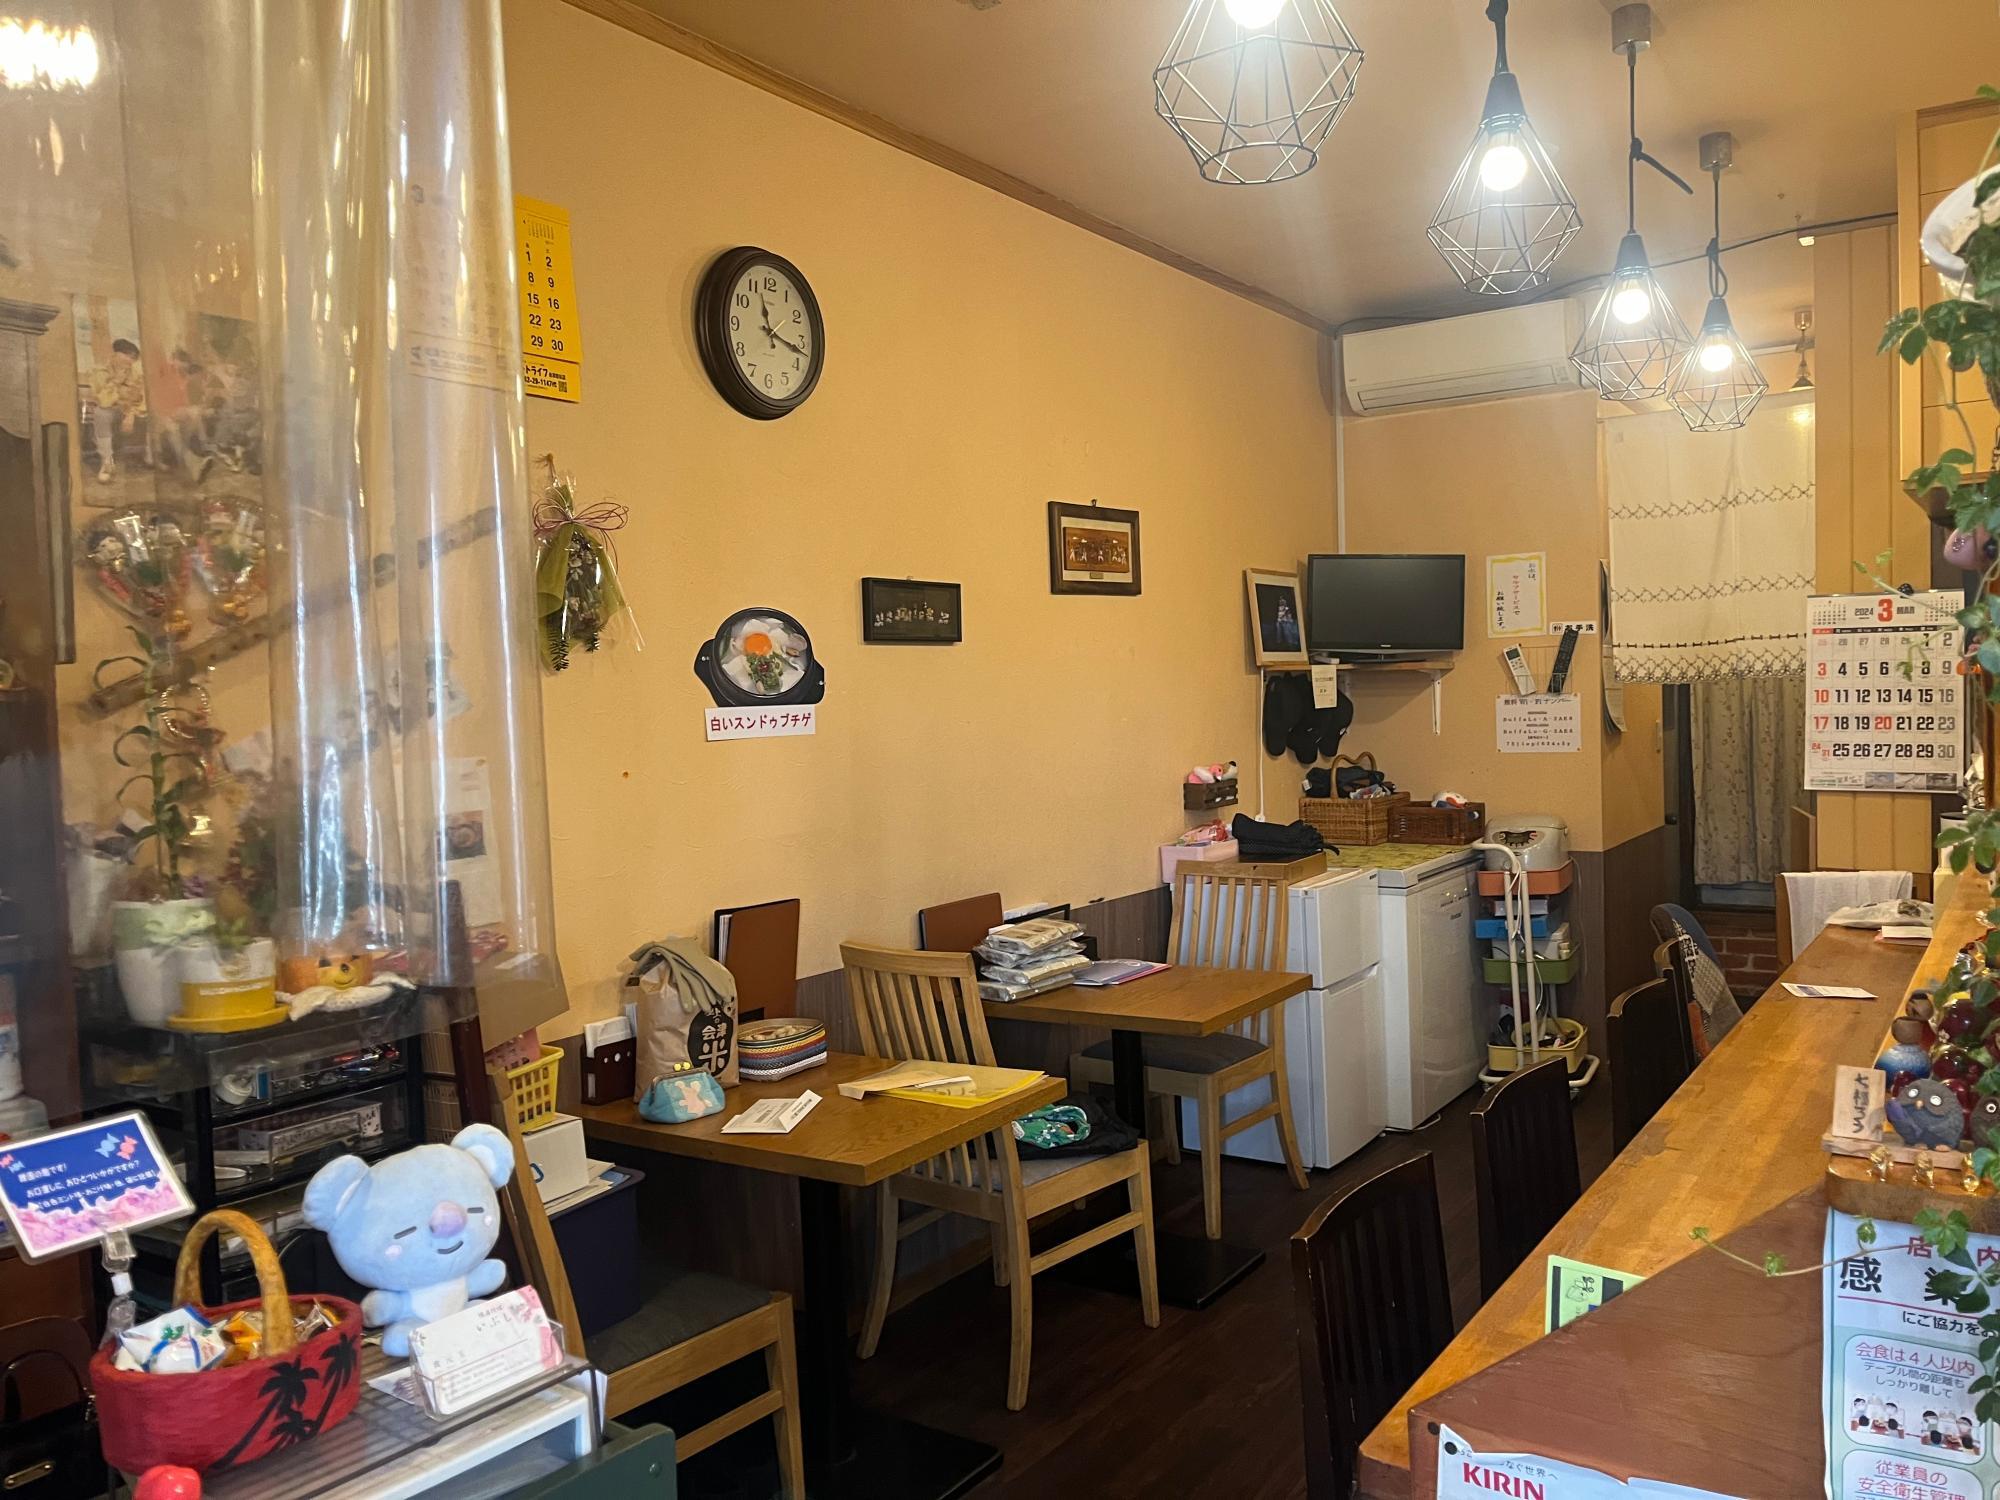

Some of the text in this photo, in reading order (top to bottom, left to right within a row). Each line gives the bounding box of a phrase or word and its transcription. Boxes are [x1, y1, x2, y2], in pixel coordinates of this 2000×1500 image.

[526, 250, 552, 268] 1 2
[528, 271, 555, 288] 8 9
[748, 278, 758, 294] 11
[763, 276, 777, 293] 12
[527, 292, 560, 310] 15 16
[736, 293, 750, 308] 10
[784, 289, 789, 303] 1
[529, 313, 562, 331] 22 23
[730, 315, 740, 331] 9
[792, 309, 802, 324] 2
[531, 335, 564, 351] 29 30
[735, 341, 745, 357] 8
[747, 362, 757, 378] 7
[791, 357, 800, 371] 4
[764, 373, 774, 389] 6
[780, 371, 790, 386] 5
[1854, 607, 1874, 617] 2024
[1877, 598, 1893, 622] 3
[1859, 637, 1869, 646] 27
[1943, 632, 1953, 647] 2
[1817, 662, 1827, 676] 3
[1838, 662, 1848, 676] 4
[1858, 662, 1869, 676] 5
[1879, 661, 1889, 675] 6
[1942, 660, 1952, 675] 9
[1814, 689, 1954, 703] 10 11 12 13 14 15 16
[710, 712, 812, 732] 白いスンドゥブチゲ
[1813, 716, 1955, 731] 17 18 19 20 21 22 23
[1833, 743, 1850, 758] 25
[1853, 743, 1871, 758] 26
[1873, 743, 1892, 758] 27
[1895, 743, 1913, 758] 28
[1916, 744, 1934, 758] 29
[1937, 744, 1955, 759] 30
[698, 1038, 729, 1073] 米
[1863, 1362, 1966, 1390] テーブル間の距離も
[1876, 1376, 1953, 1399] しっかり離して
[1876, 1459, 1948, 1486] 従業員の
[1463, 1462, 1545, 1500] KIRIN
